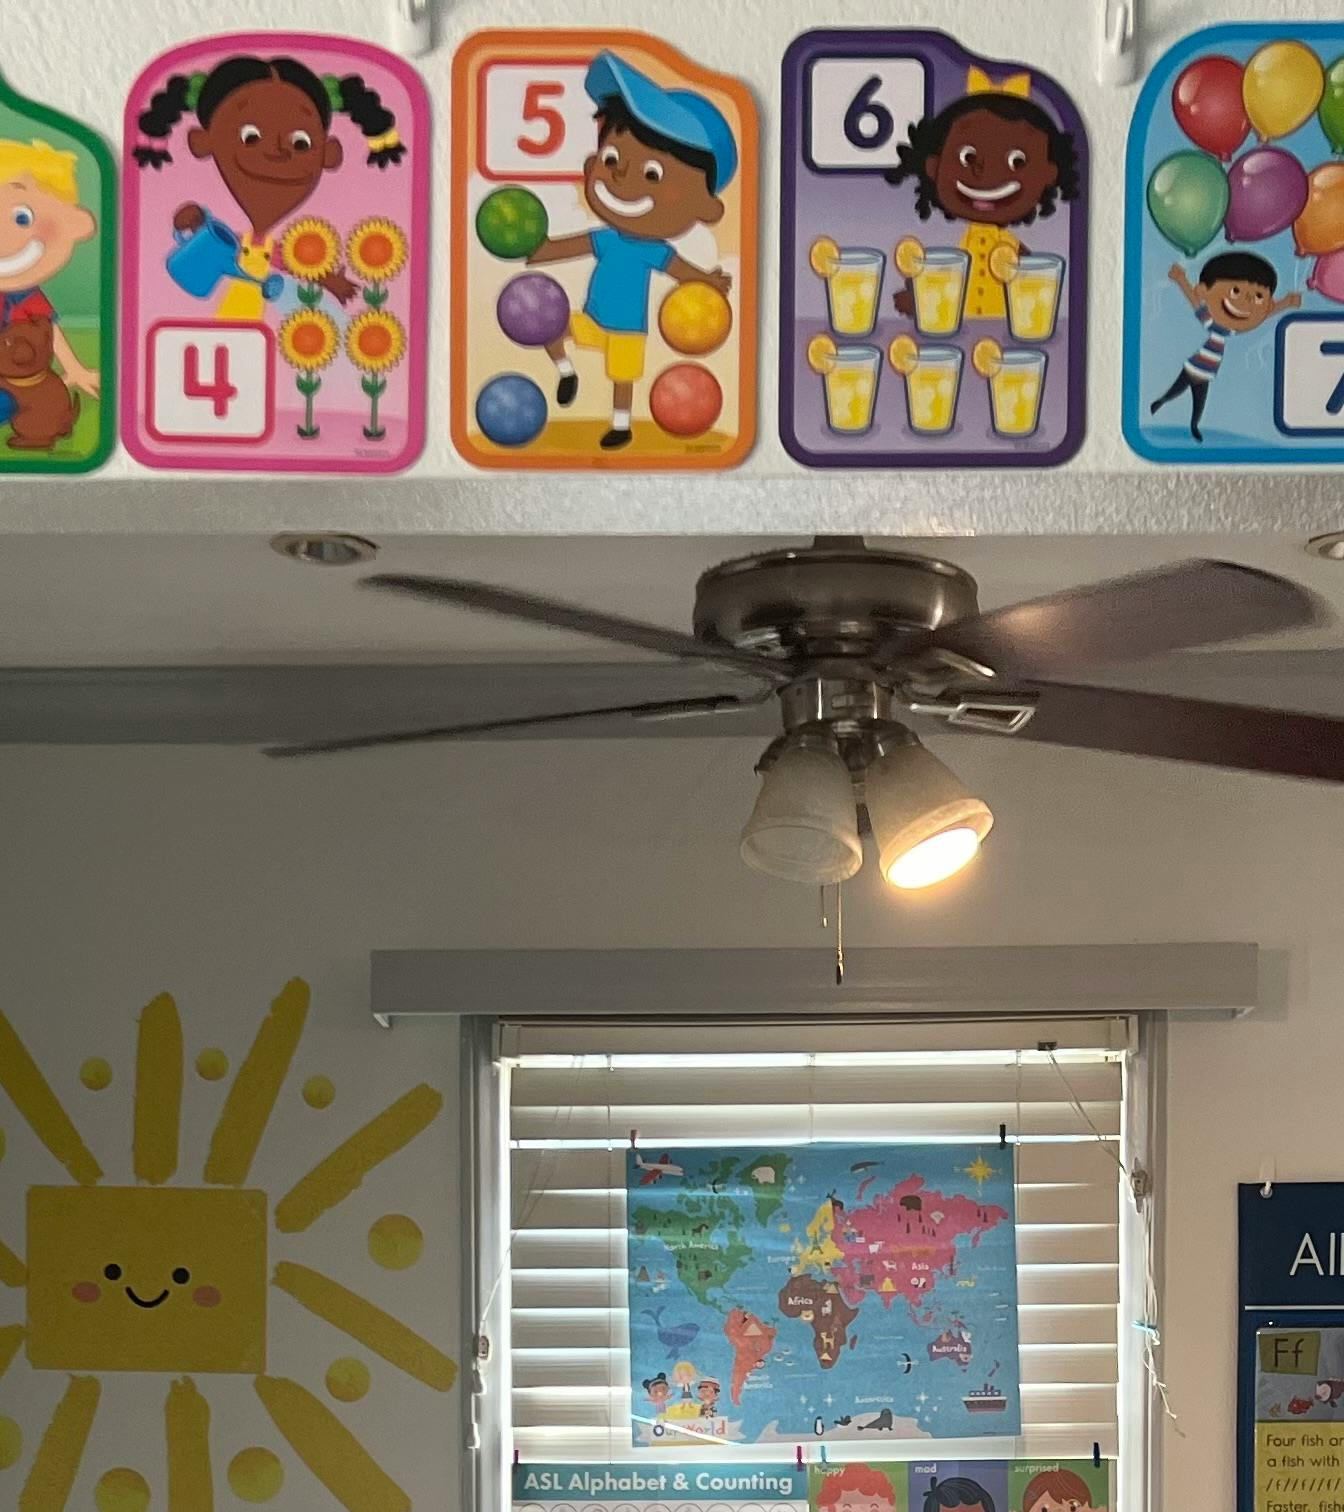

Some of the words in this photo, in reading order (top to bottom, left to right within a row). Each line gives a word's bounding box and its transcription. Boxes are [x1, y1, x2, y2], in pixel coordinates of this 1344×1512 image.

[515, 79, 567, 156] 5
[843, 75, 895, 150] 6
[181, 343, 238, 418] 4
[688, 1240, 719, 1251] America
[911, 1262, 930, 1271] Asia
[787, 1296, 814, 1306] Africa
[932, 1344, 968, 1353] Australia
[1273, 1337, 1305, 1368] Ff
[1265, 1434, 1296, 1447] Four
[1301, 1434, 1324, 1447] fish
[1266, 1457, 1277, 1468] a
[1281, 1454, 1305, 1468] fish
[1308, 1454, 1340, 1468] with
[914, 1463, 937, 1474] mad
[1014, 1463, 1060, 1476] surprised
[523, 1472, 564, 1491] ASL
[568, 1472, 667, 1496] Alphabet
[672, 1472, 689, 1491] &
[695, 1471, 794, 1496] Counting
